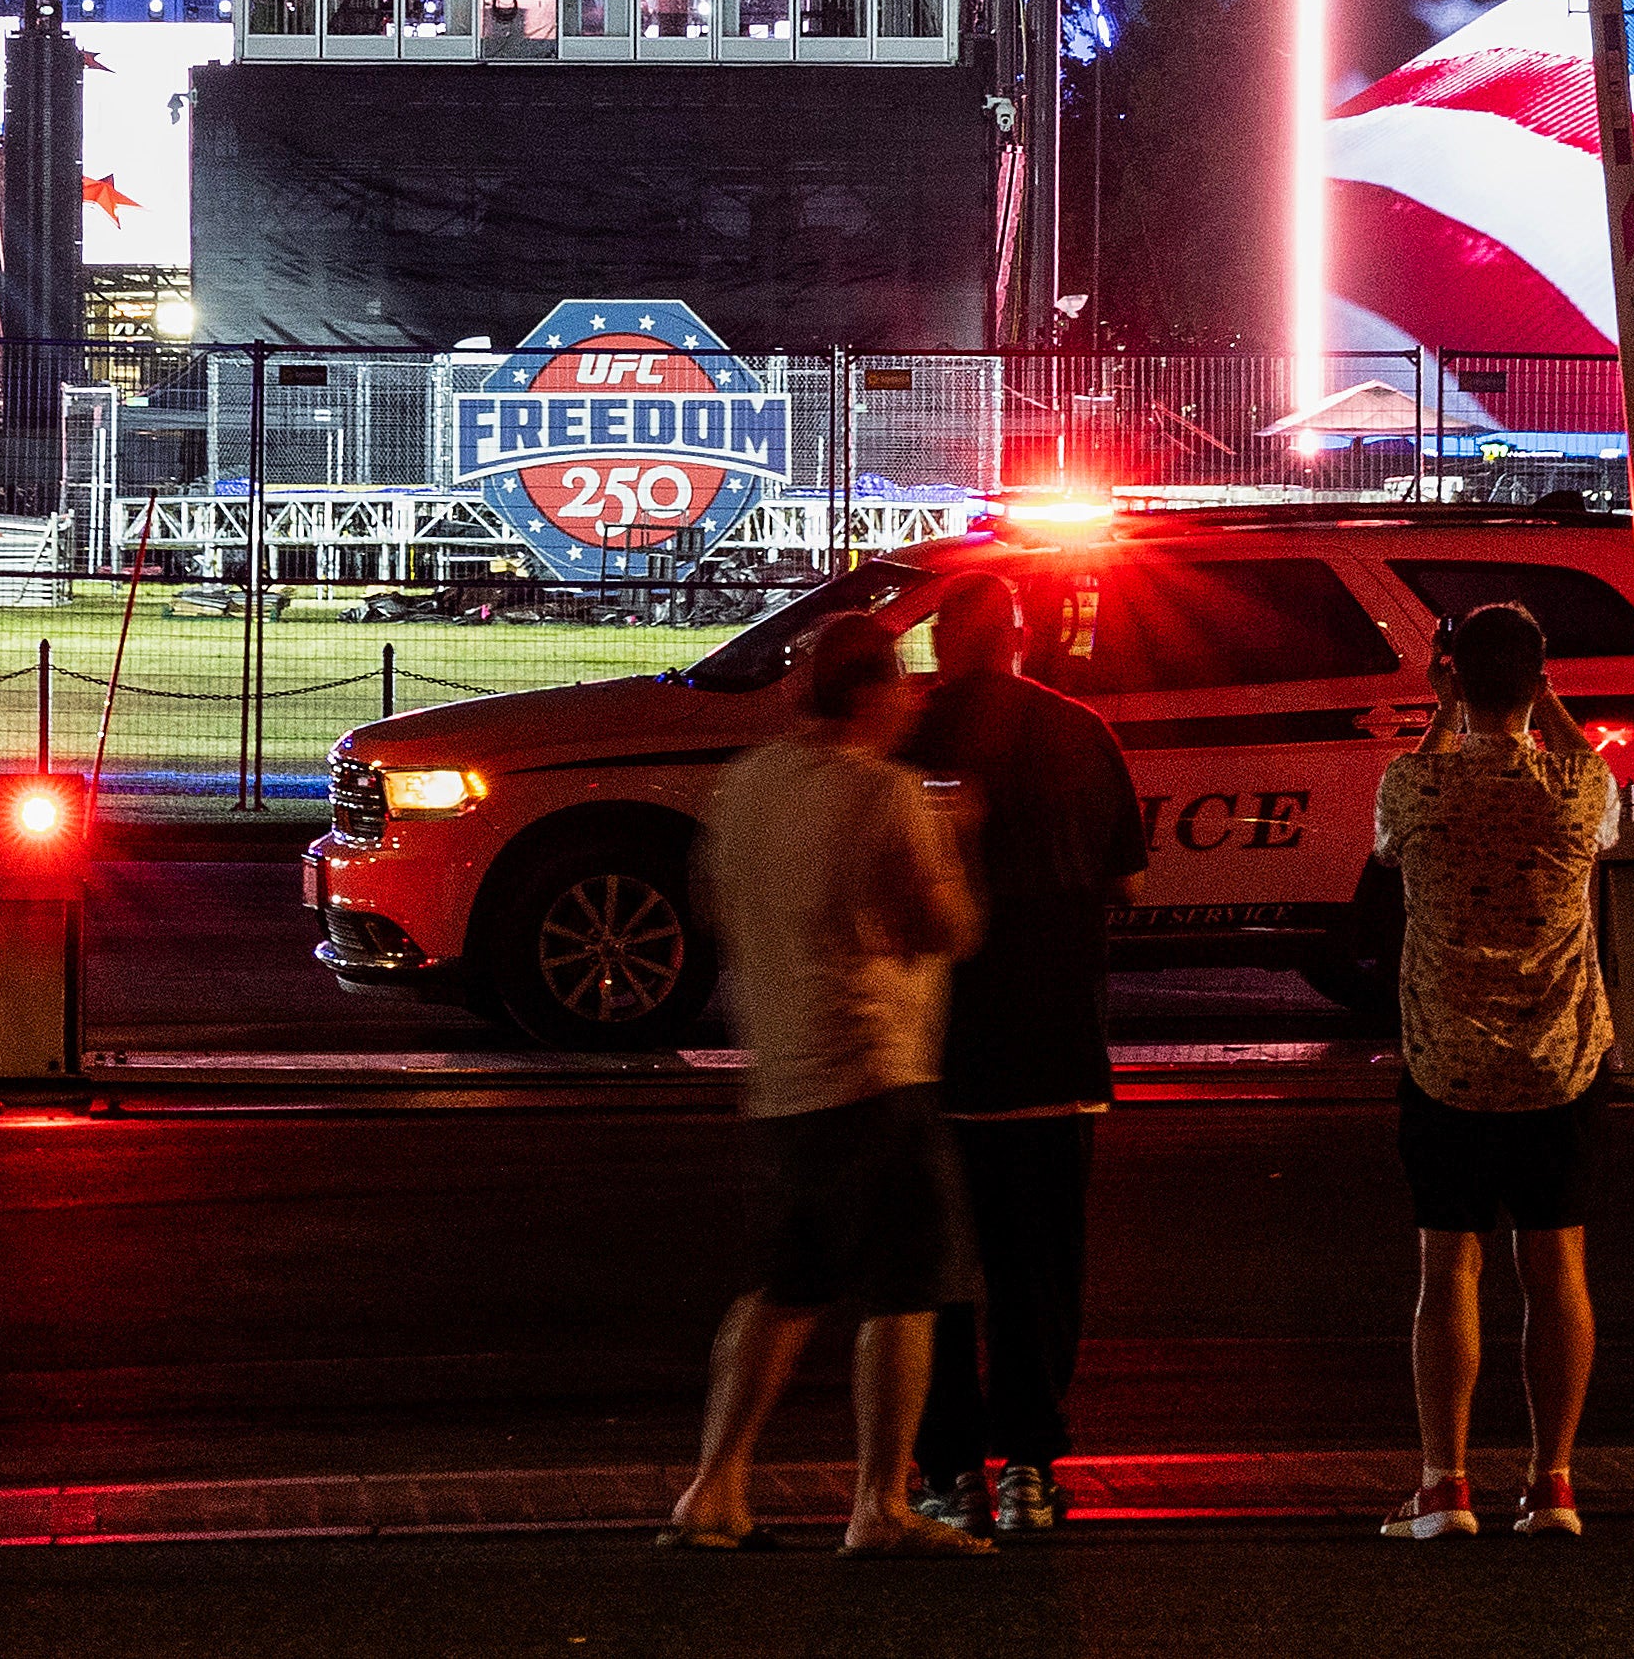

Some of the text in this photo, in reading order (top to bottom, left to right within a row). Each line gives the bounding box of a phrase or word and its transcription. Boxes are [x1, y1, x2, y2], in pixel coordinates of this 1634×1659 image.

[576, 353, 668, 385] UFC
[459, 399, 786, 478] FREEDOM
[557, 465, 693, 537] 250
